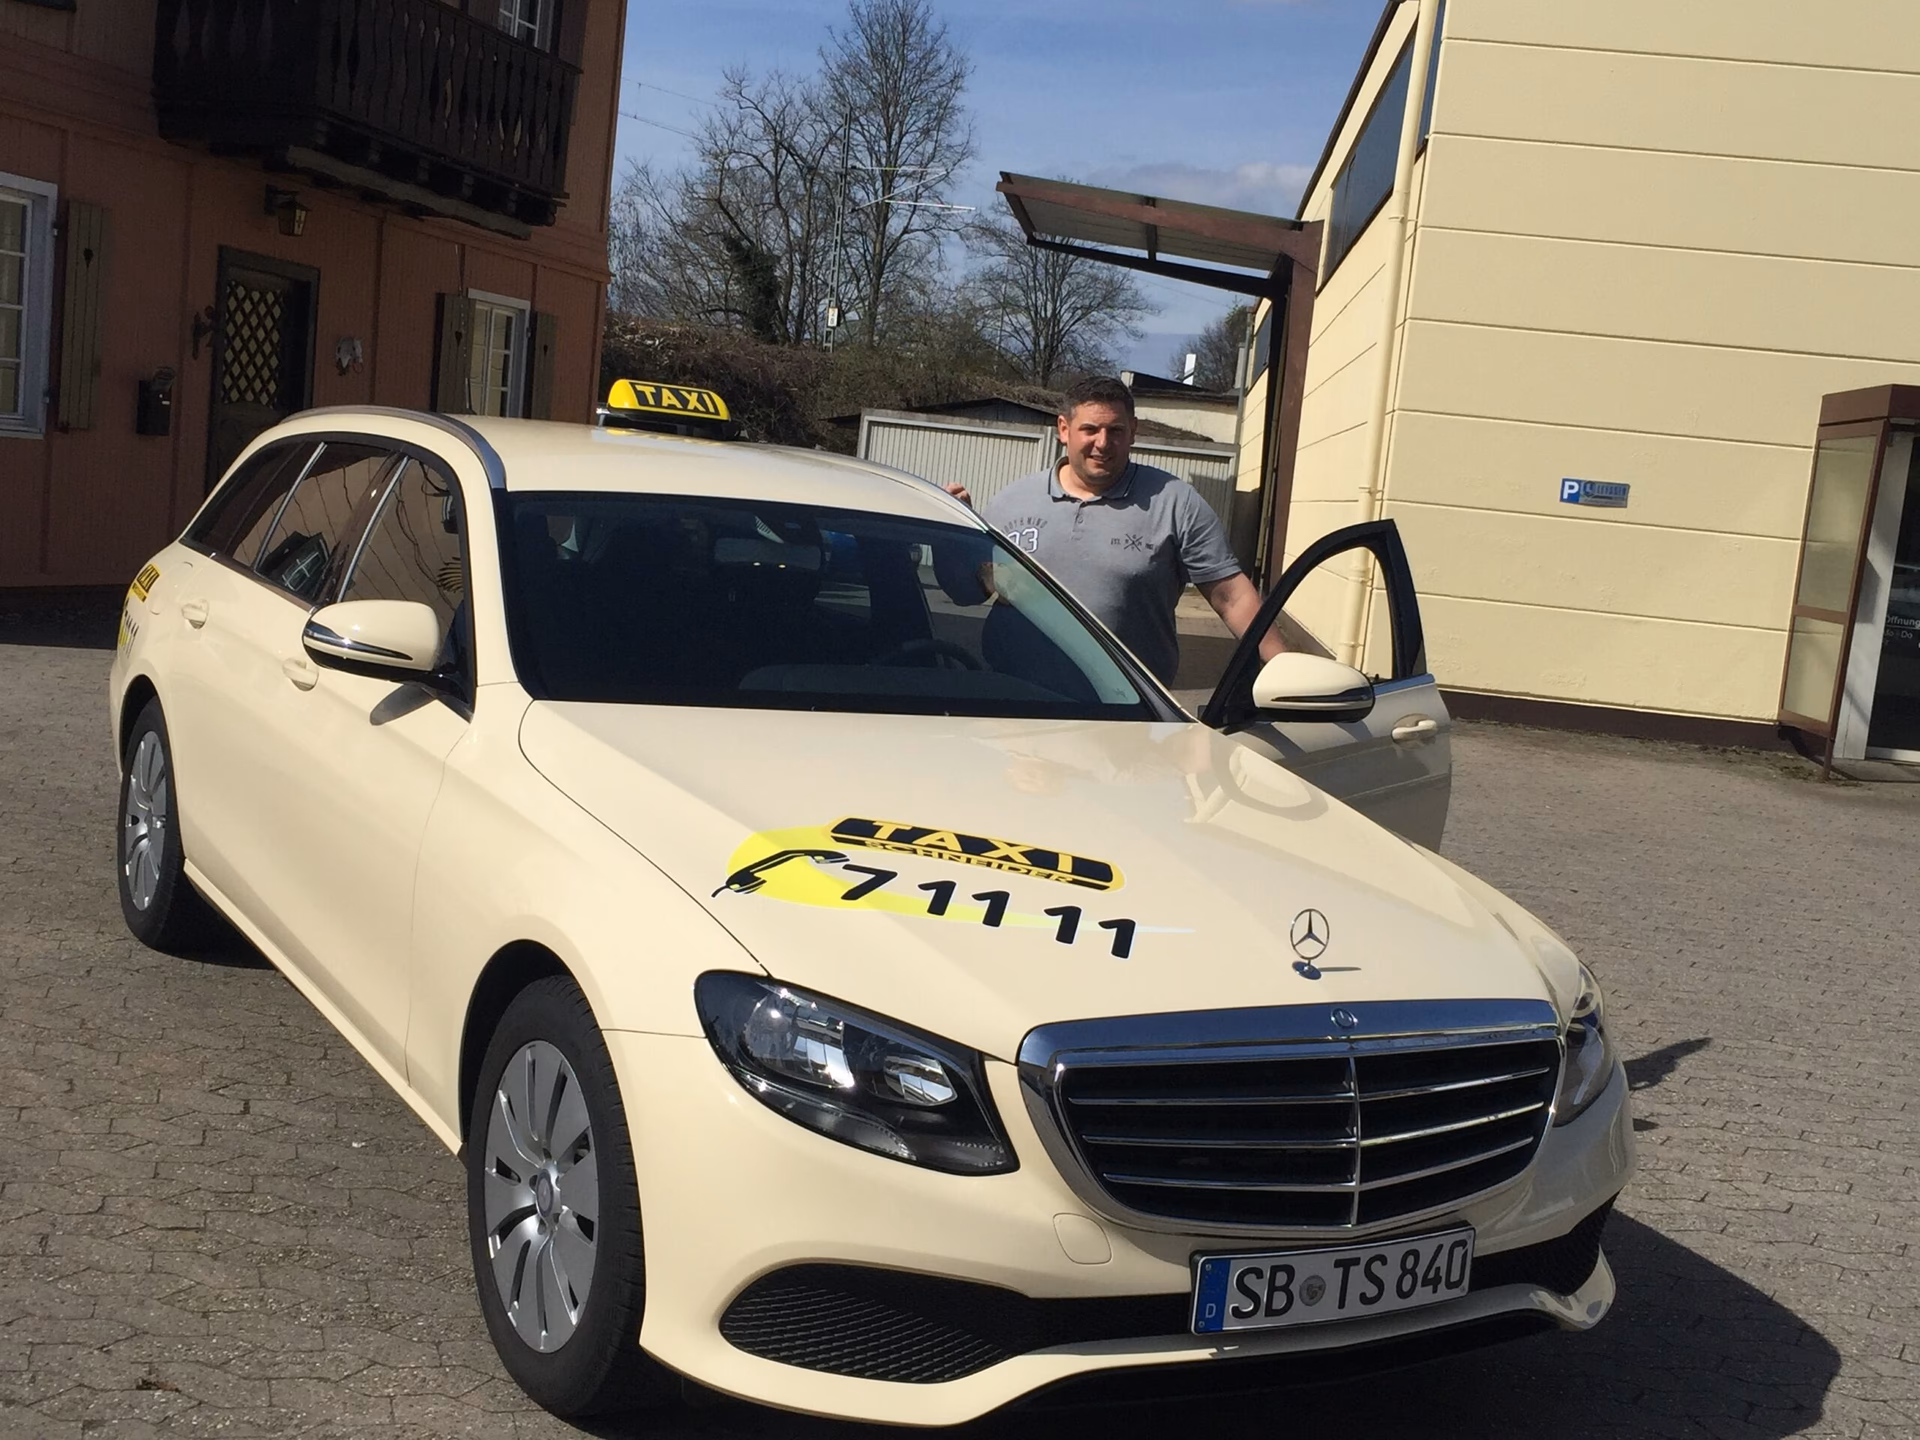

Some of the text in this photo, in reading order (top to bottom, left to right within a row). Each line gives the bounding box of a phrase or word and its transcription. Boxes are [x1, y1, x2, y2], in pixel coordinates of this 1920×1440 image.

[635, 385, 715, 413] TAXI
[1563, 481, 1579, 499] P
[863, 840, 1074, 885] SCHNEIDER
[871, 820, 1074, 874] TAXI
[1229, 1264, 1296, 1320] SB
[1205, 1303, 1217, 1318] D
